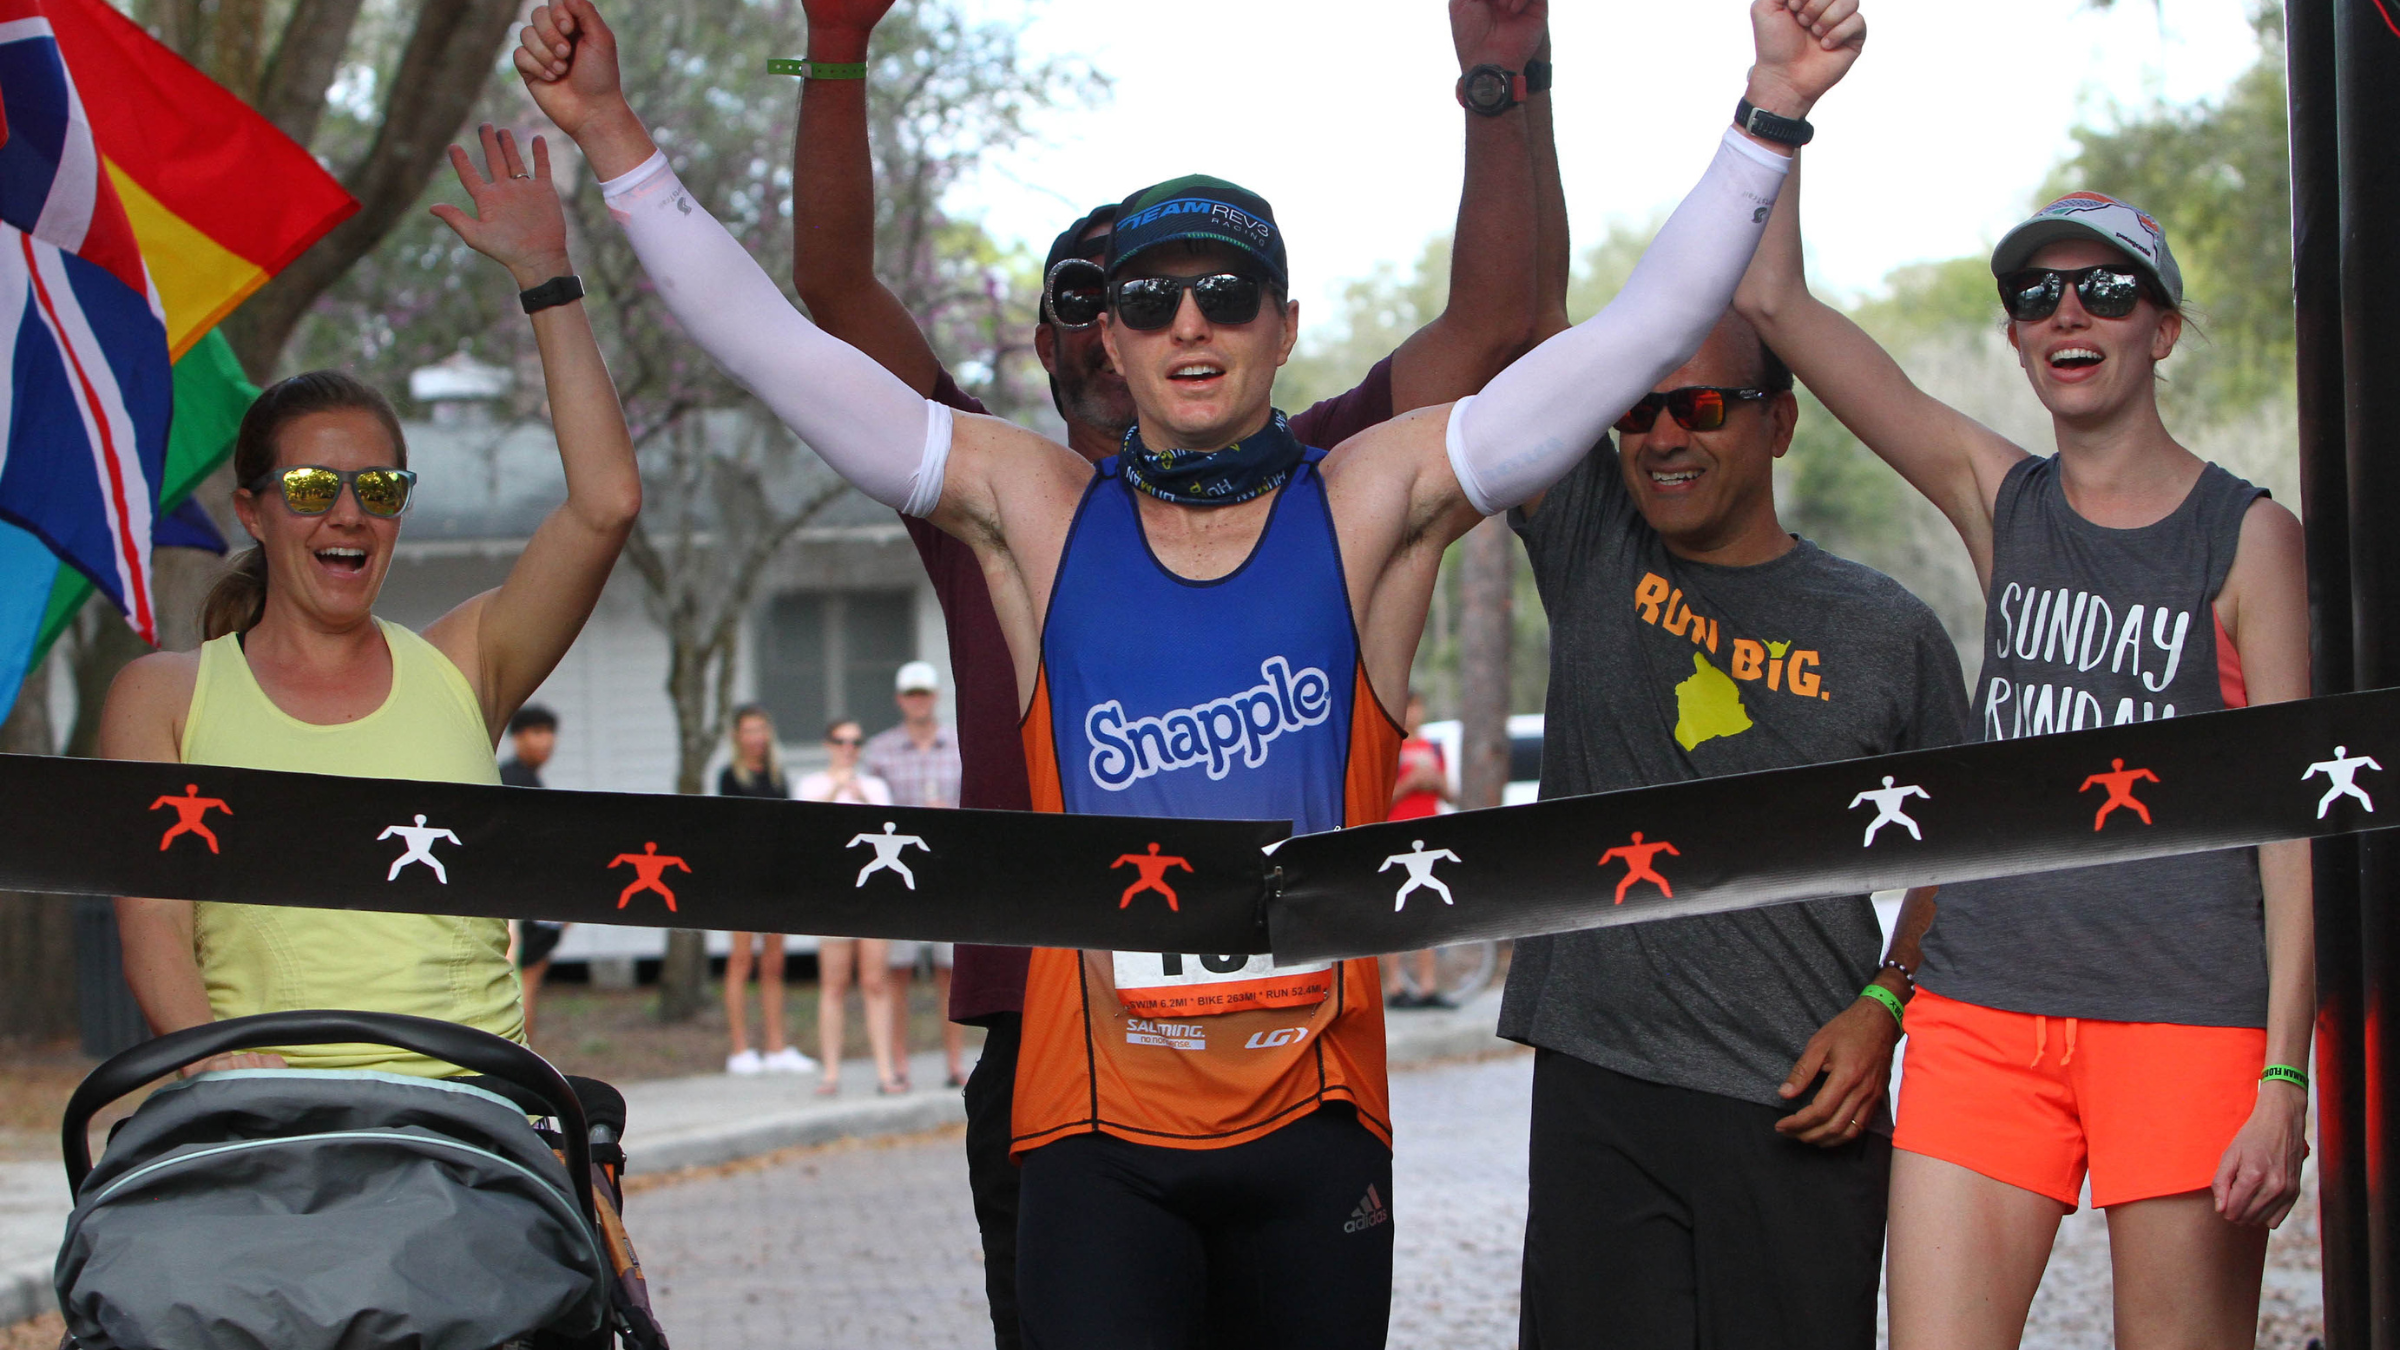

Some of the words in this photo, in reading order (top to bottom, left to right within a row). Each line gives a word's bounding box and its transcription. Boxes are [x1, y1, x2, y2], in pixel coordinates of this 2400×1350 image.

[1117, 202, 1210, 231] TEAM
[1212, 204, 1270, 238] REV3
[1211, 217, 1265, 247] RACING
[2116, 232, 2151, 257] patagonia
[1635, 572, 1718, 655] RUN
[1997, 582, 2190, 692] SUNDAY
[1085, 655, 1331, 792] Snapple
[1985, 677, 2175, 741] RUN
[1129, 1000, 1158, 1009] SWIM
[1160, 998, 1188, 1008] 6.2MI
[1197, 996, 1223, 1006] BIKE
[1227, 992, 1256, 1003] 263MI
[1266, 988, 1289, 999] RUN
[1292, 985, 1322, 996] 52.4MI
[1344, 1208, 1388, 1234] adidas
